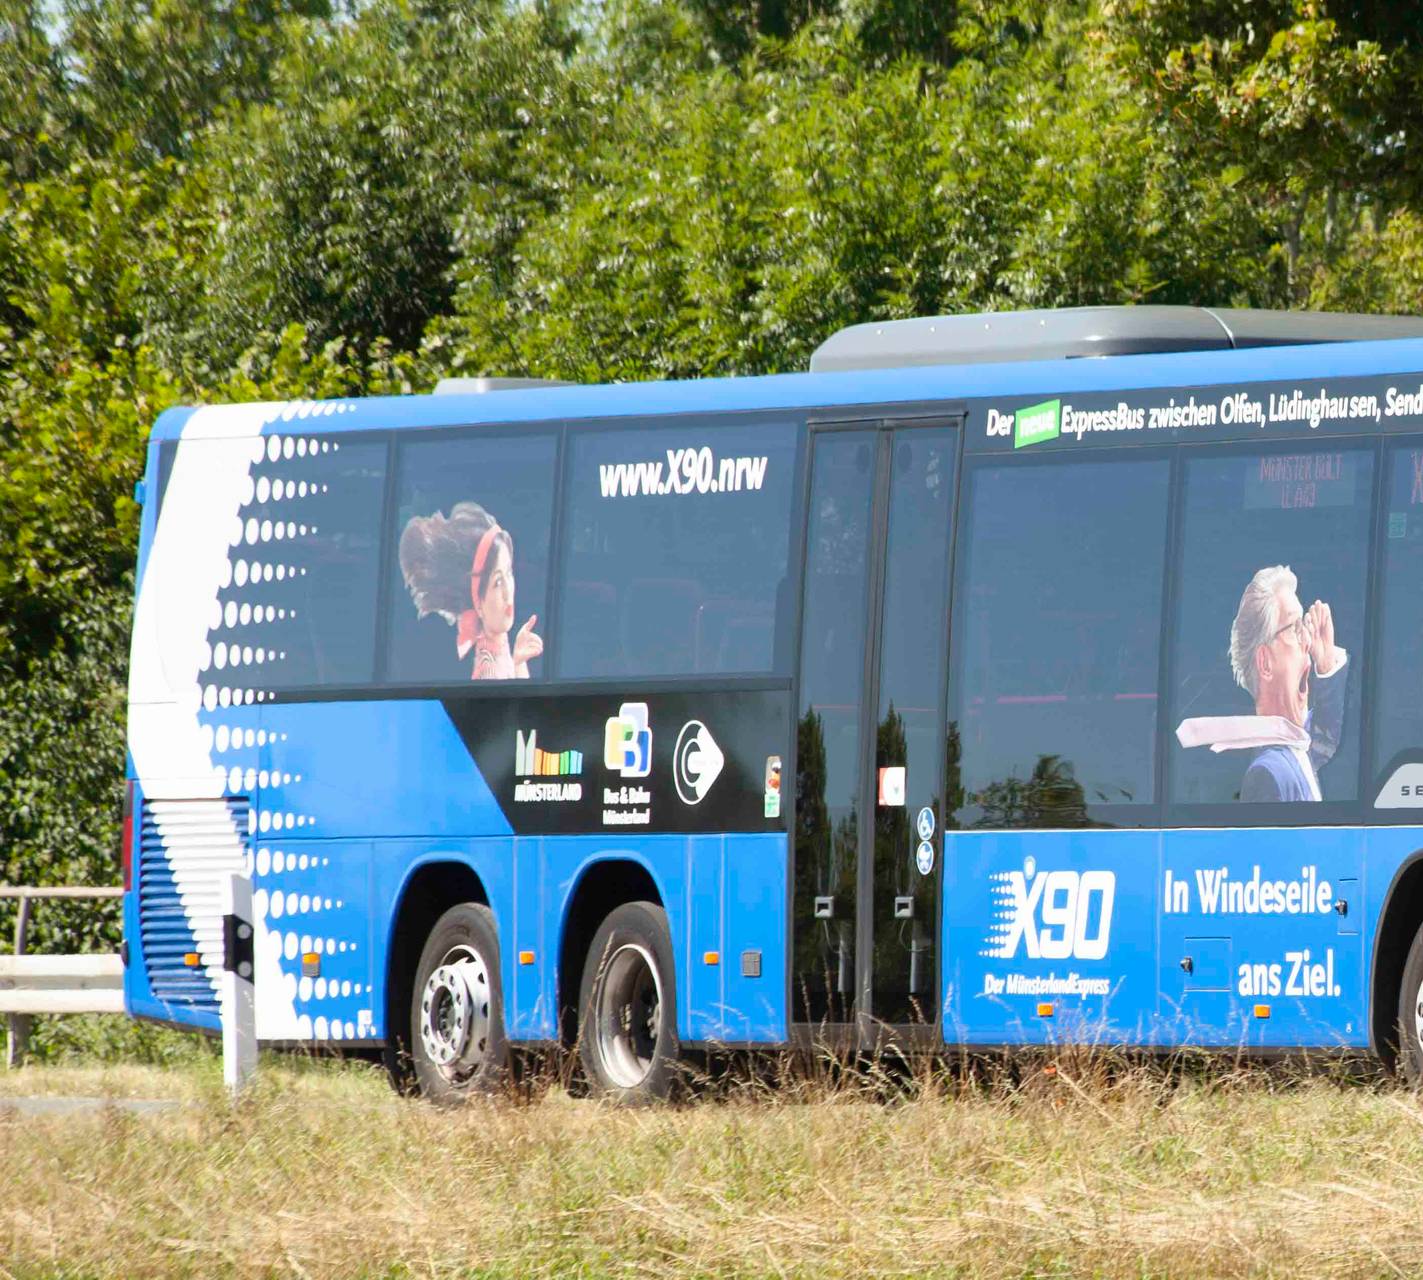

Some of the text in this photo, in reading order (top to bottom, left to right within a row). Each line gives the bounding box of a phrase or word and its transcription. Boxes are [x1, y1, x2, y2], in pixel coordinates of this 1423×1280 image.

[986, 409, 1014, 436] Der
[1019, 409, 1056, 438] neue
[1060, 402, 1145, 440] ExpressBus
[1148, 396, 1217, 429] zwischen
[1219, 393, 1266, 428] Olfen,
[599, 446, 768, 498] www.X90.nrw
[514, 779, 582, 802] MÜNSTERLAND
[619, 786, 628, 804] &
[1164, 865, 1332, 914] In Windeseile
[1000, 868, 1115, 960] X90
[984, 972, 1110, 1000] Der MünsterlandExpress
[1238, 948, 1341, 997] ans Ziel.
